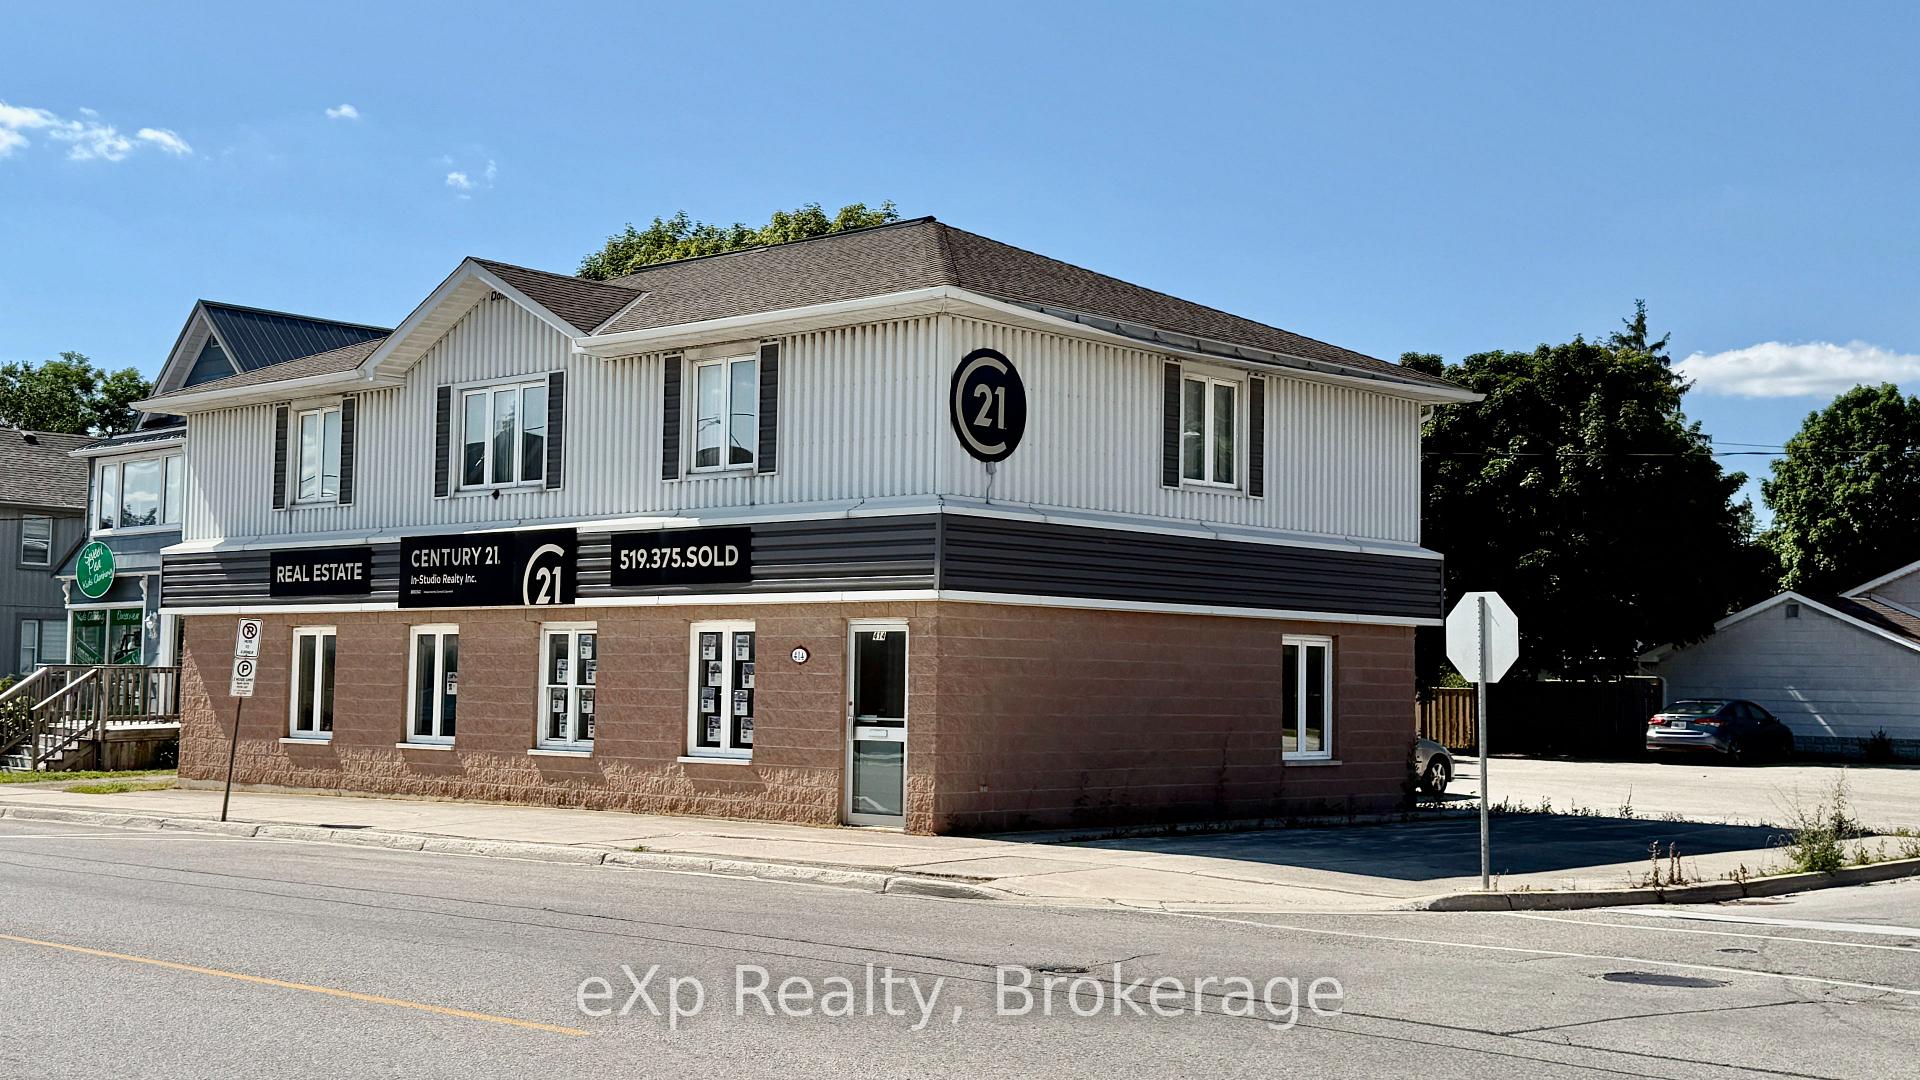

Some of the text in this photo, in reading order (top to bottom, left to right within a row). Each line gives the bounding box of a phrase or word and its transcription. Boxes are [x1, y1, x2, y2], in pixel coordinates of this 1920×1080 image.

[973, 383, 1006, 430] 21
[411, 546, 482, 568] CENTURY
[620, 545, 739, 570] 519.375.SOLD
[276, 562, 363, 583] REAL ESTATE
[410, 572, 477, 586] In-Studio Realty Inc.
[535, 566, 563, 605] 21
